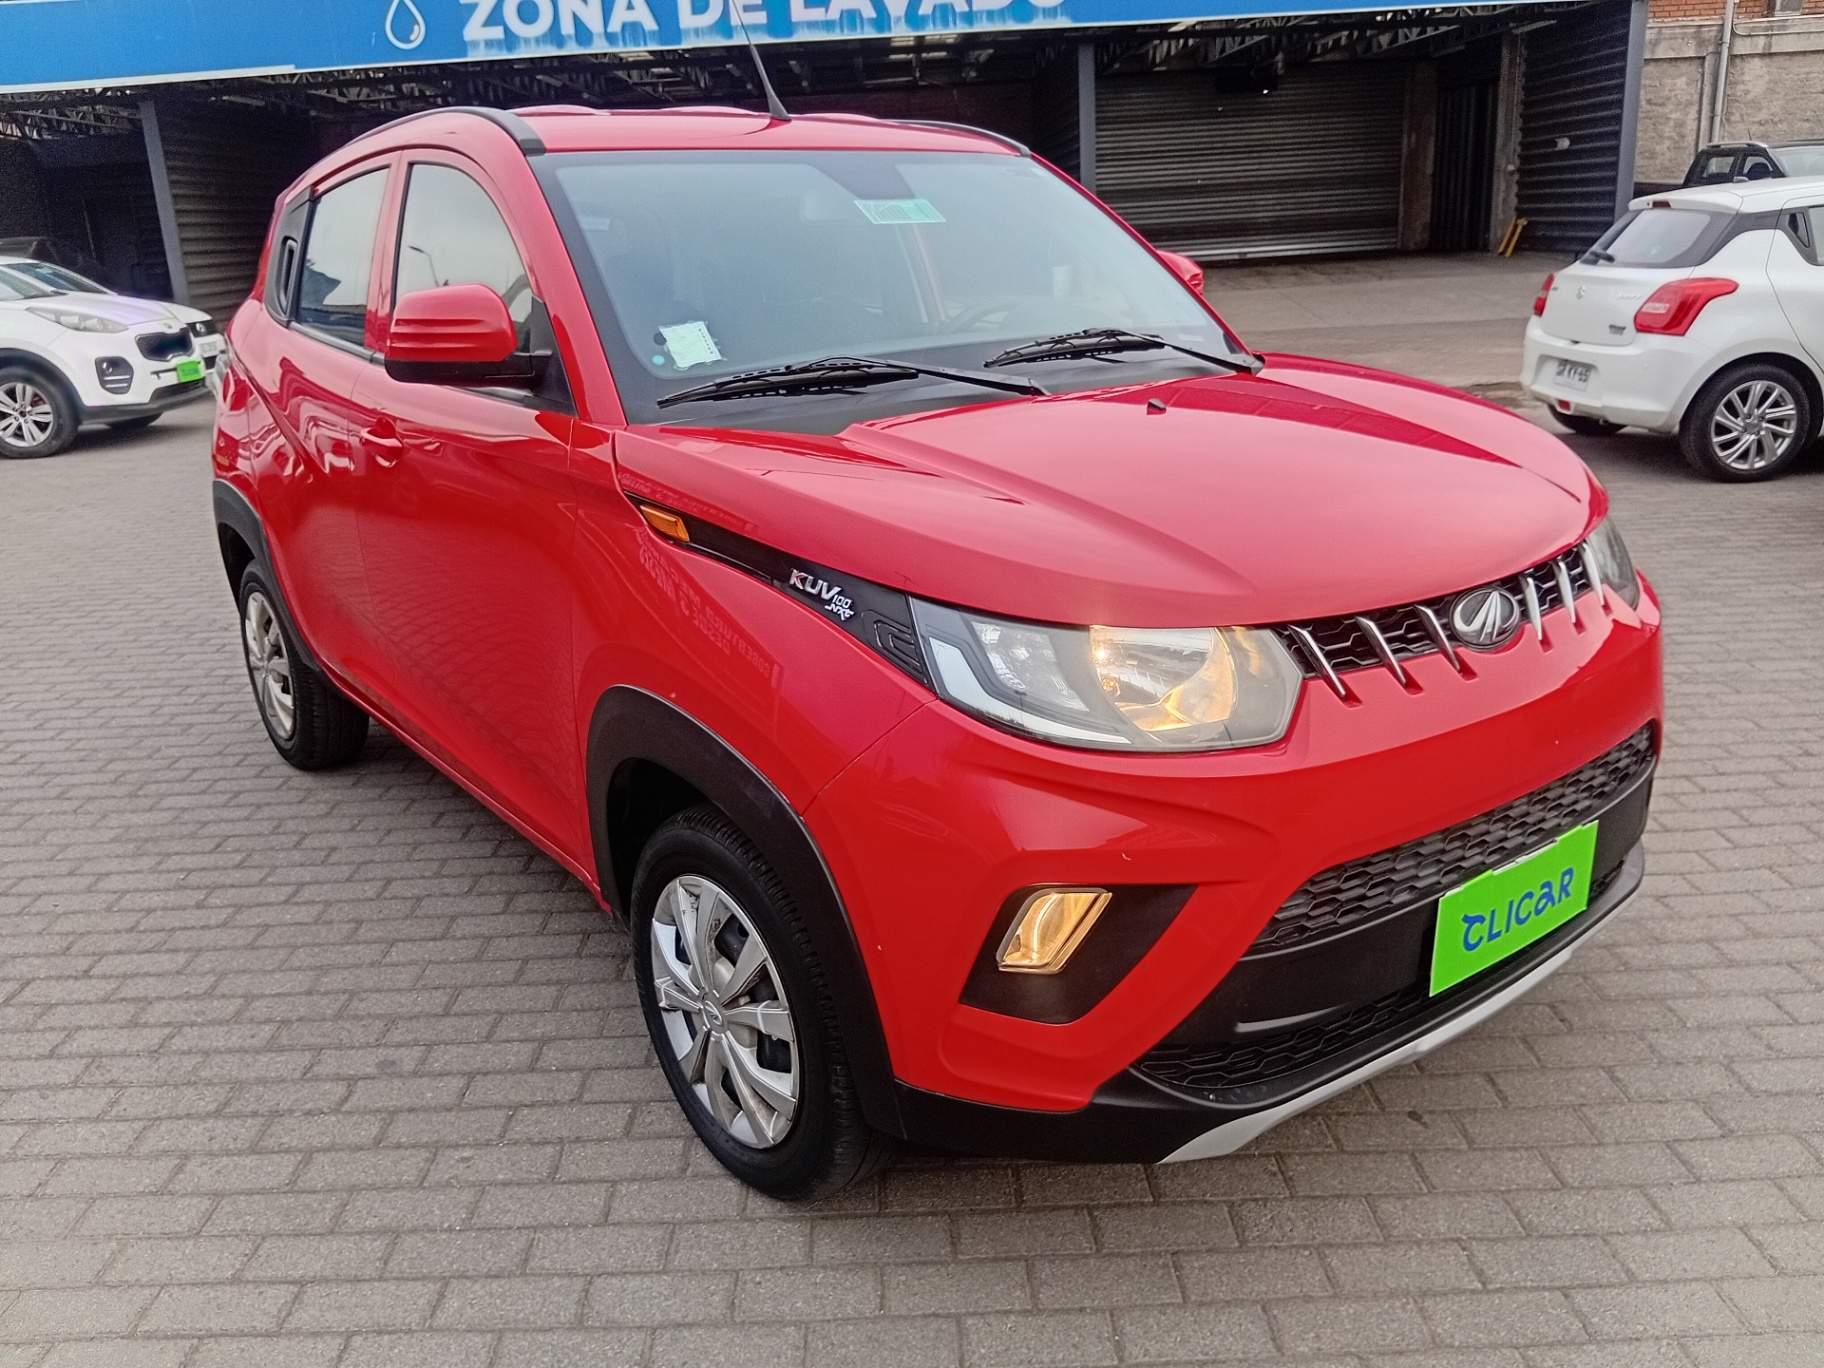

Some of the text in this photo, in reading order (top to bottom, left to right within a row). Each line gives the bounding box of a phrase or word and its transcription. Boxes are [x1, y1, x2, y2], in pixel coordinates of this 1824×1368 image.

[460, 0, 659, 40] ZONA
[789, 568, 852, 608] KUV 100
